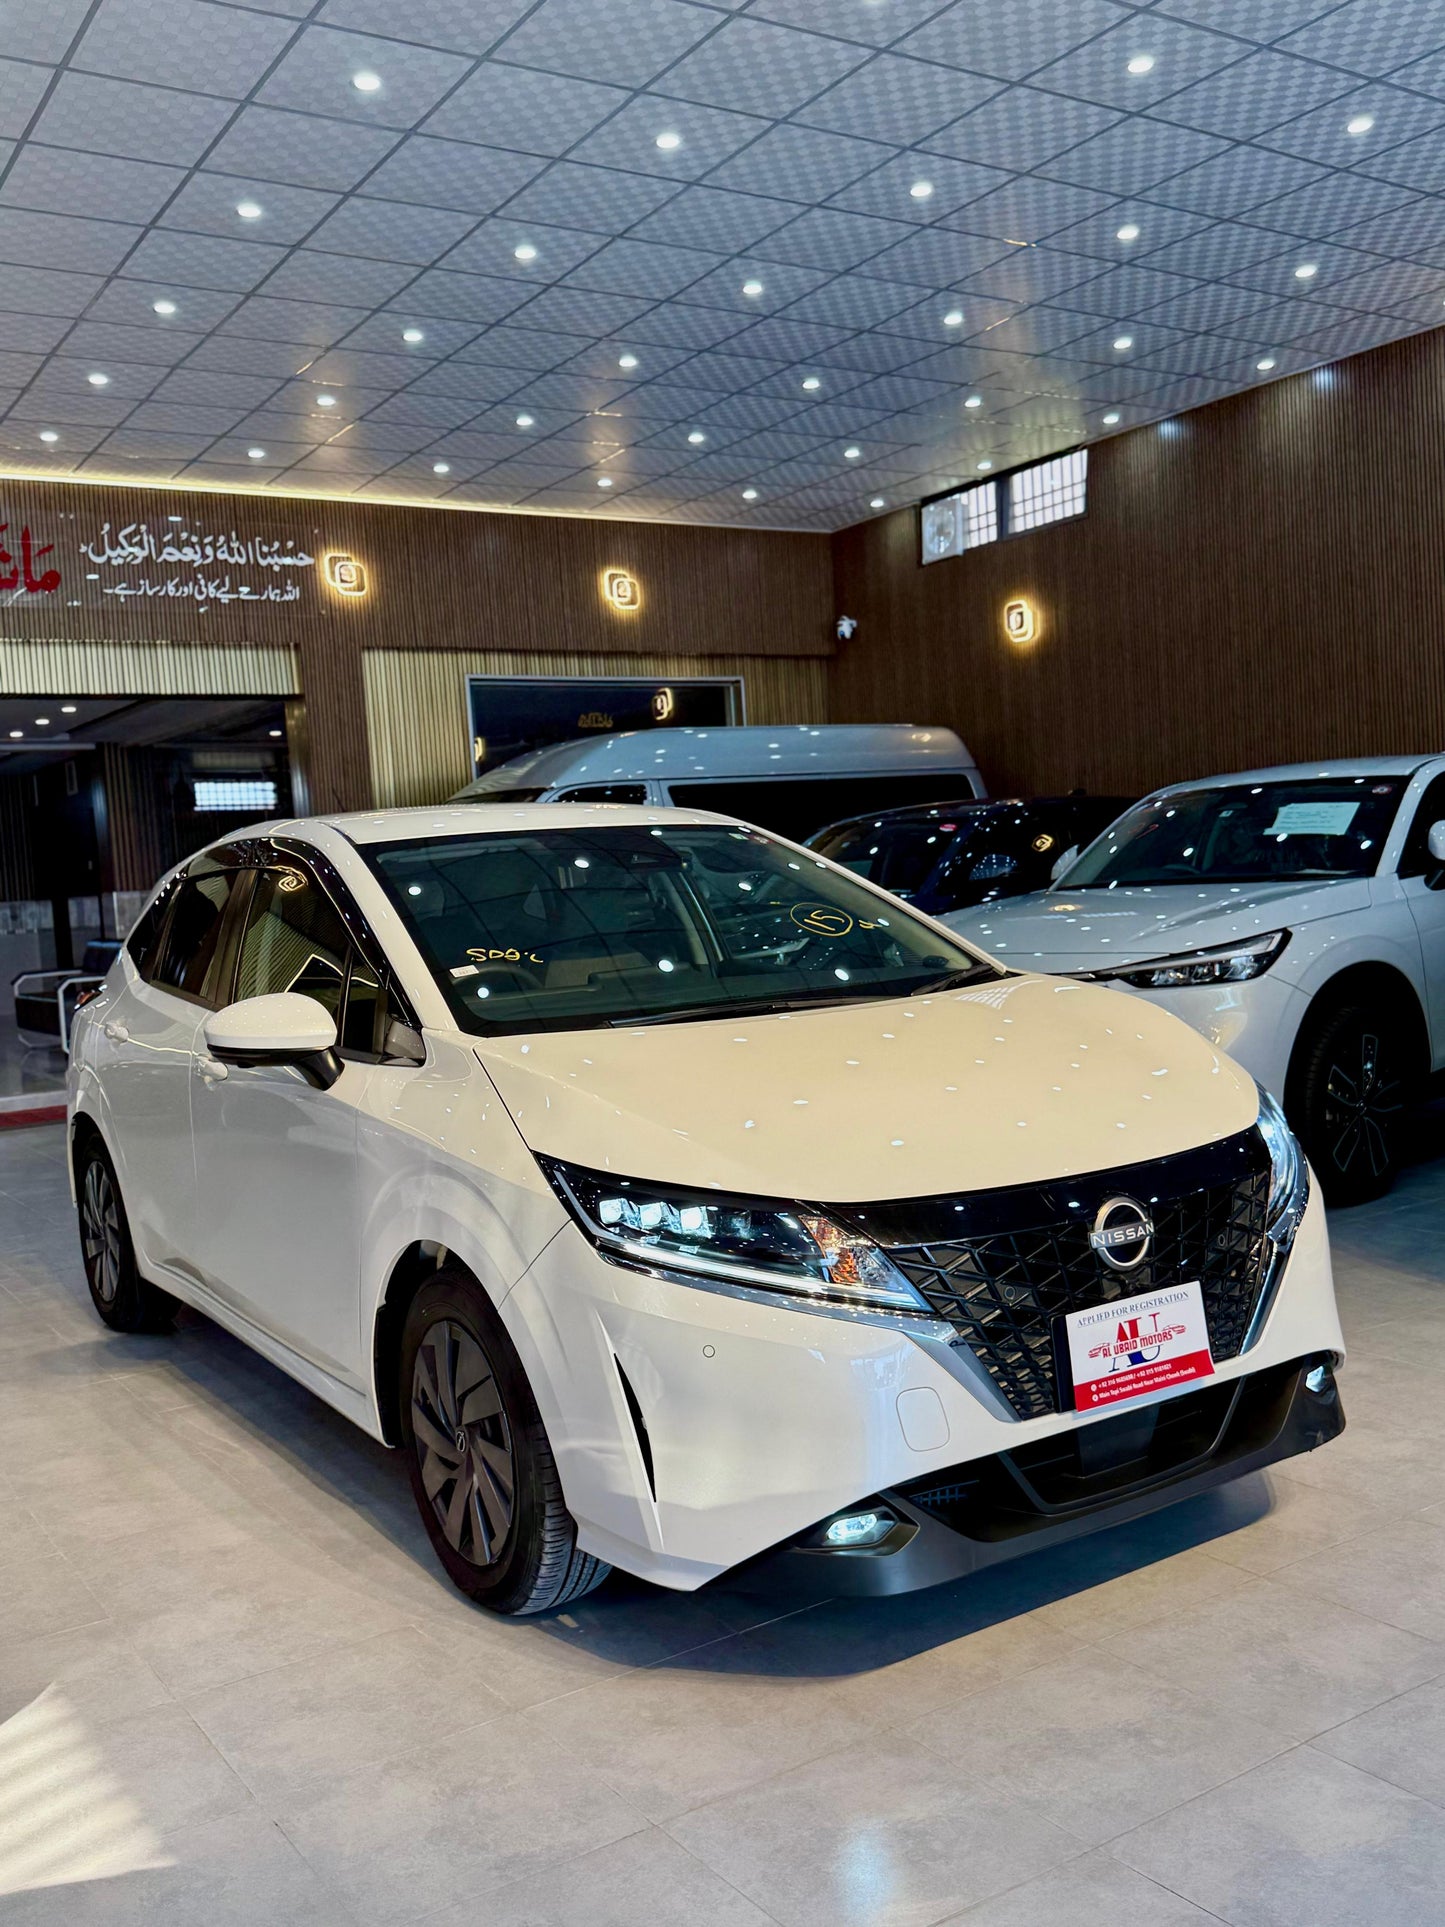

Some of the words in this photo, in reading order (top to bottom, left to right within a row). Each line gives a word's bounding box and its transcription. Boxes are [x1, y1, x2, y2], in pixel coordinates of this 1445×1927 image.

[1092, 1222, 1154, 1247] NISSAN
[1077, 1312, 1110, 1327] APPLIED
[1112, 1306, 1128, 1317] FOR
[1129, 1291, 1189, 1312] REGISTRATION
[1102, 1346, 1112, 1358] AL
[1113, 1340, 1138, 1355] UBAID
[1140, 1330, 1173, 1348] MOTORS
[1133, 1381, 1144, 1390] Road
